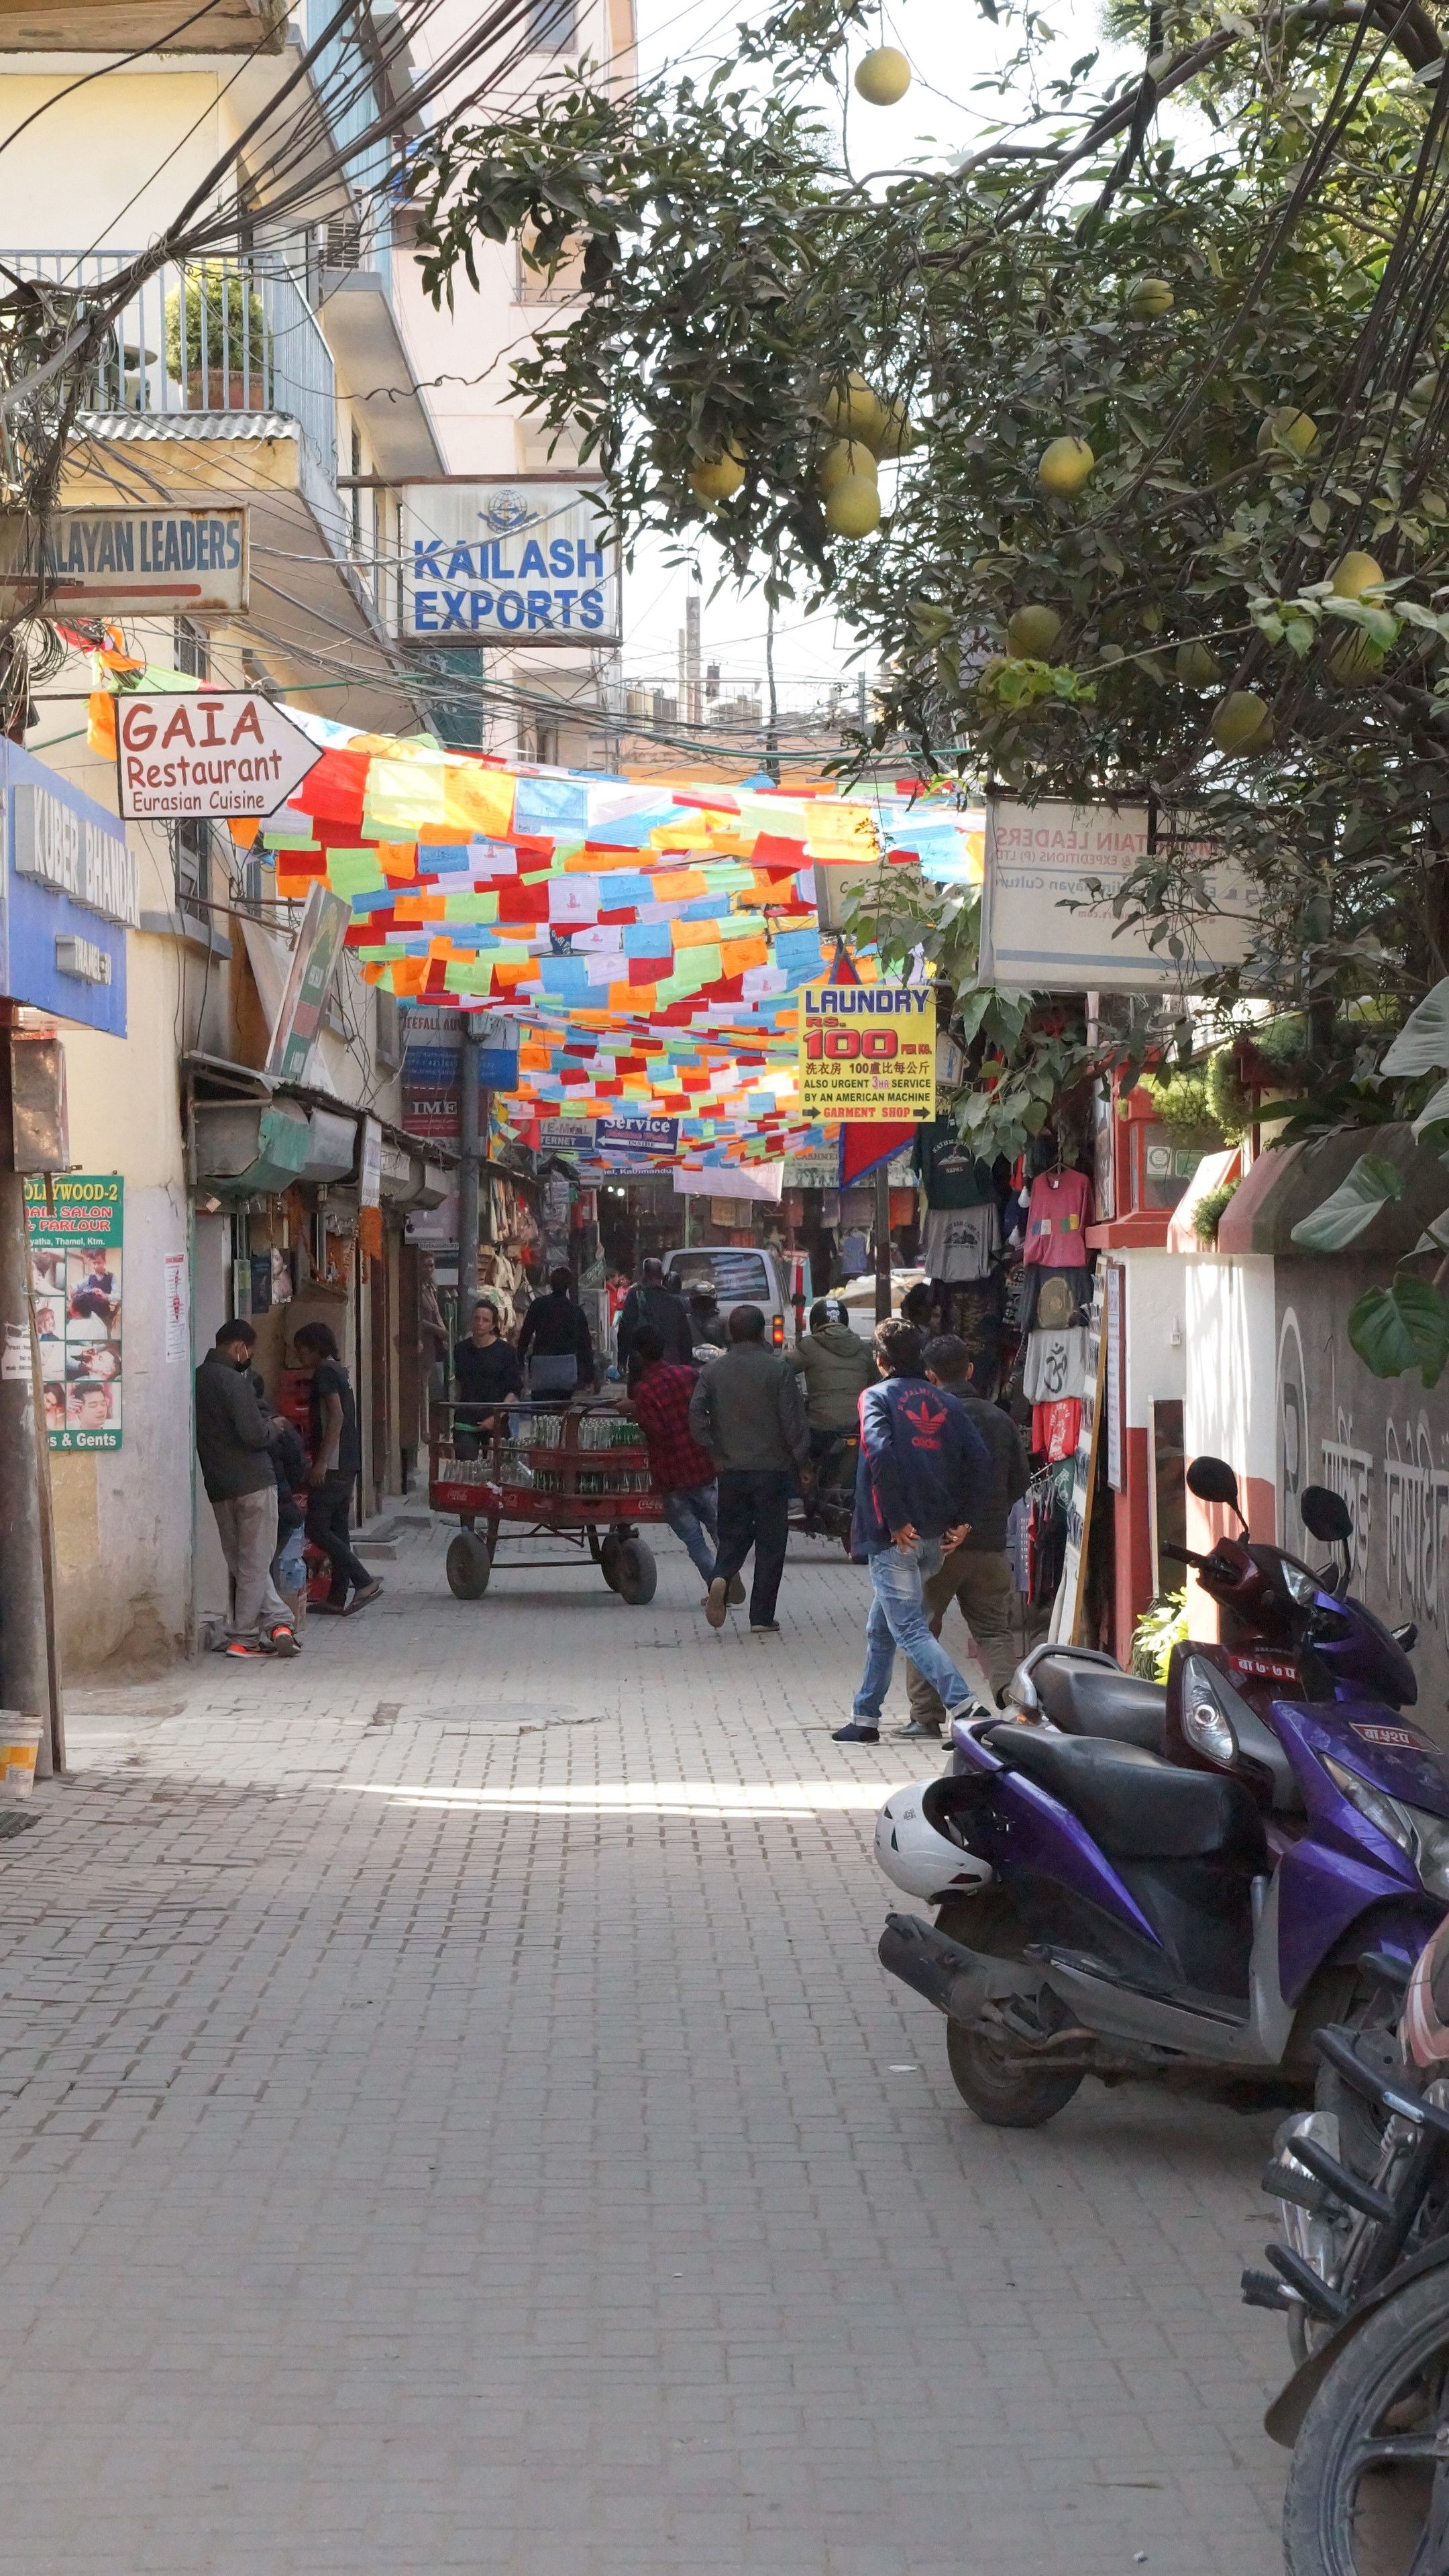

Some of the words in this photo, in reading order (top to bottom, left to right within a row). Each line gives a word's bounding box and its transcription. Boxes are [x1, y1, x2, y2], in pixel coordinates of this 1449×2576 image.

[140, 519, 240, 572] LEADERS
[415, 539, 604, 580] KAILASH
[415, 589, 604, 631] EXPORTS
[123, 700, 264, 752] GAIA
[127, 749, 282, 790] Restaurant
[133, 791, 201, 812] Eurasian
[209, 790, 265, 810] Cuisine
[34, 784, 80, 896] KUBER
[805, 989, 930, 1014] LAUNDRY
[803, 1029, 898, 1059] 100
[901, 1044, 916, 1055] PER
[806, 1063, 842, 1075] 洗衣房
[804, 1079, 828, 1088] ALSO
[831, 1079, 869, 1088] URGENT
[872, 1076, 890, 1089] 3HR
[892, 1079, 931, 1088] SERVICE
[805, 1093, 817, 1102] BY
[820, 1093, 833, 1102] AN
[837, 1093, 884, 1102] AMERICAN
[888, 1093, 930, 1102] MACHINE
[413, 1102, 457, 1115] IME
[823, 1107, 875, 1118] GARMENT
[882, 1107, 910, 1118] SHOP
[60, 1205, 113, 1218] SALON
[40, 1220, 111, 1232] PARLOUR
[30, 1238, 53, 1246] yatha,
[56, 1237, 85, 1246] Thamel,
[87, 1237, 105, 1245] Ktm.
[62, 1433, 72, 1446] &
[77, 1432, 116, 1446] Gents
